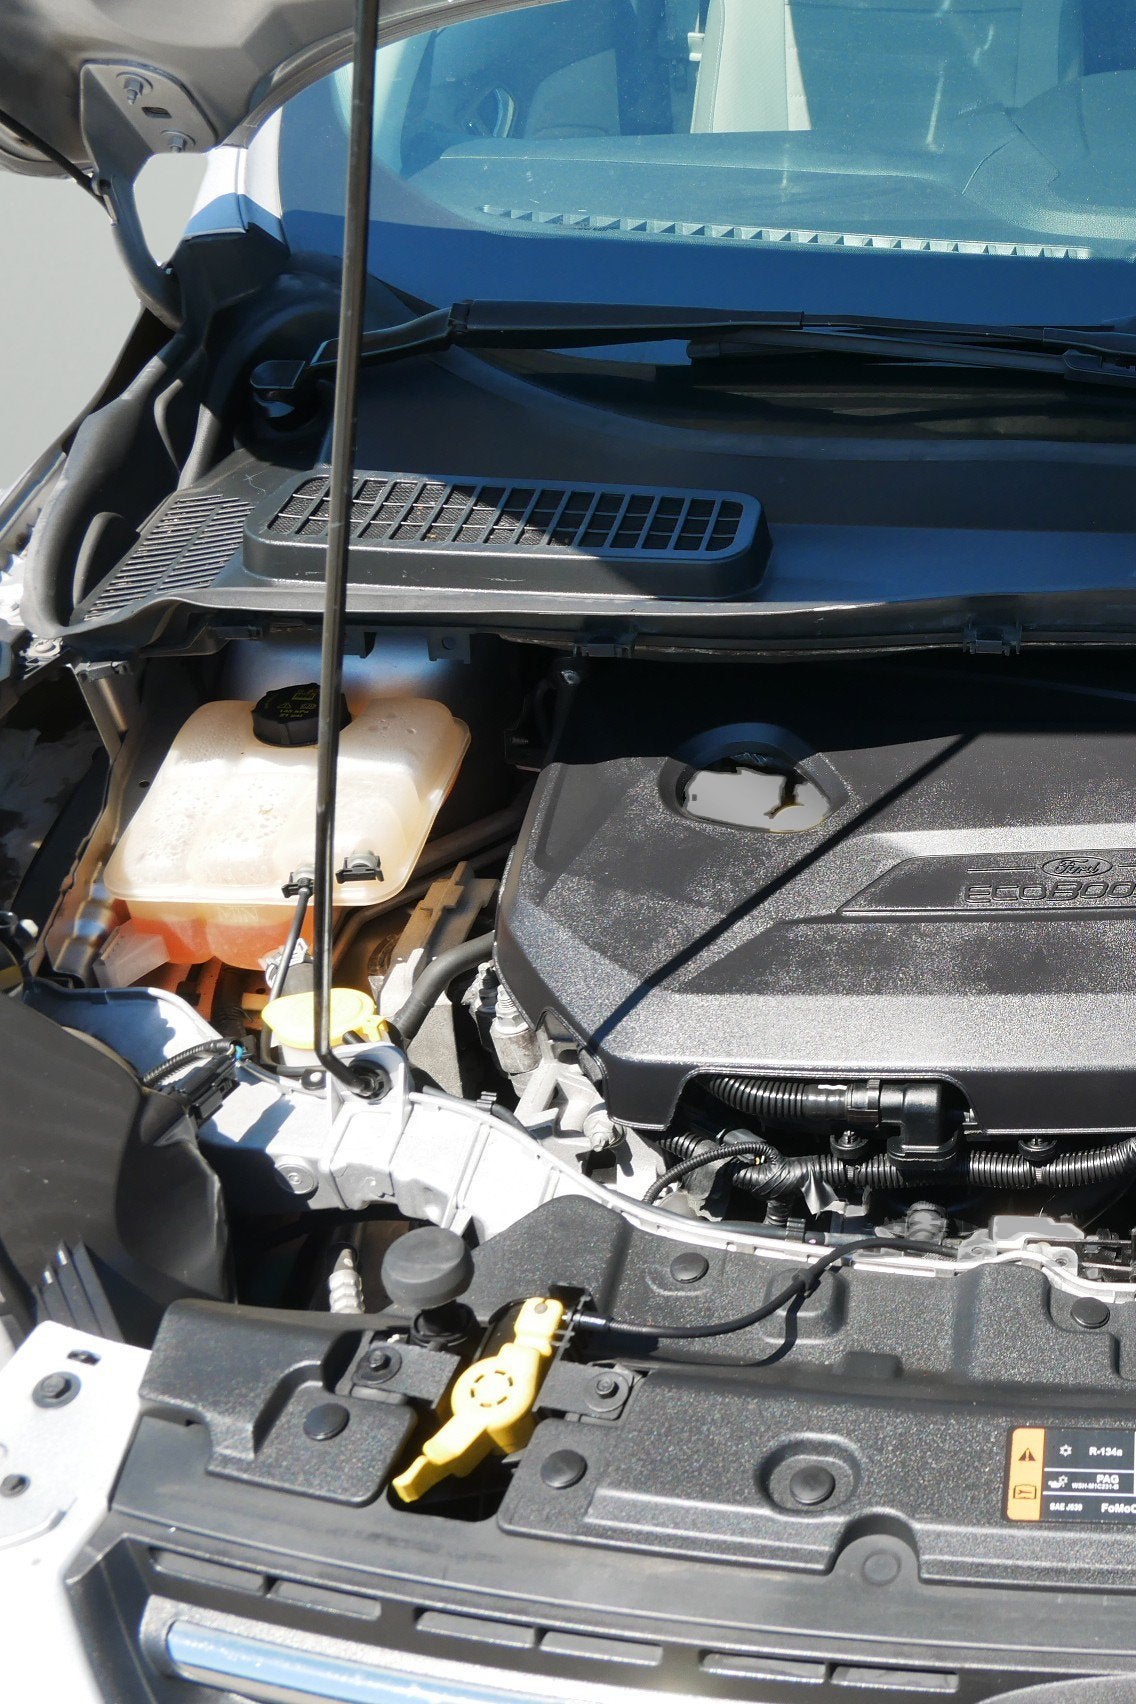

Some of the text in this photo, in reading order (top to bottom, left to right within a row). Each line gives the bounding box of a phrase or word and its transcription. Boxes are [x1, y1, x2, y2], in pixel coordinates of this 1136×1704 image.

[1054, 858, 1100, 876] Ford
[1088, 1446, 1123, 1457] R-134a
[1096, 1474, 1119, 1484] PAG
[1049, 1502, 1065, 1511] SAE
